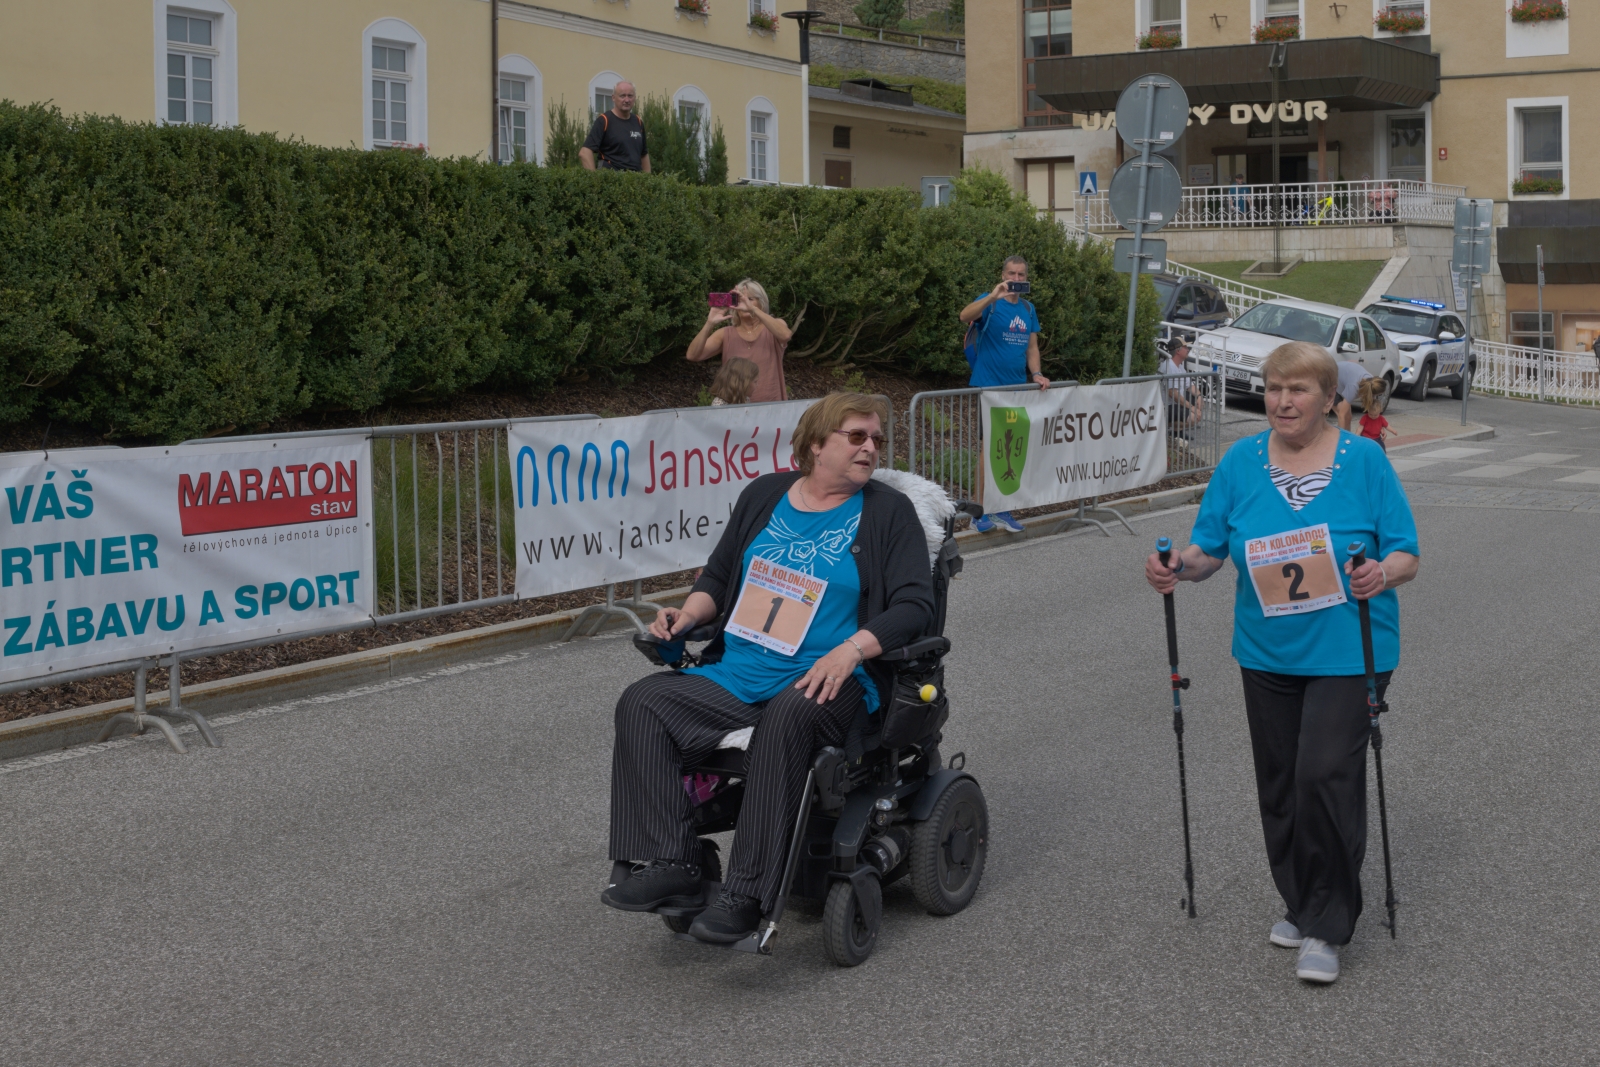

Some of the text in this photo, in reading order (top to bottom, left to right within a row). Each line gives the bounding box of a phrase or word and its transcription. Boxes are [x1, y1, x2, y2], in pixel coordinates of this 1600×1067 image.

[1230, 100, 1328, 124] DVŮR
[1233, 370, 1248, 379] 4268
[1041, 403, 1158, 446] MĚSTO ÚPICE
[644, 426, 760, 494] Janské
[1056, 455, 1141, 484] www.upice.cz
[5, 469, 94, 524] VÁŠ
[178, 460, 357, 507] MARATON
[310, 500, 352, 516] stav
[183, 524, 358, 553] tělovýchovná jednota Úpice
[1269, 528, 1325, 550] KOLONÁDOU
[751, 560, 823, 594] BĚH KOLONÁDOU
[1282, 563, 1310, 601] 2
[4, 570, 360, 657] ZÁBAVU A SPORT
[762, 597, 784, 634] 1
